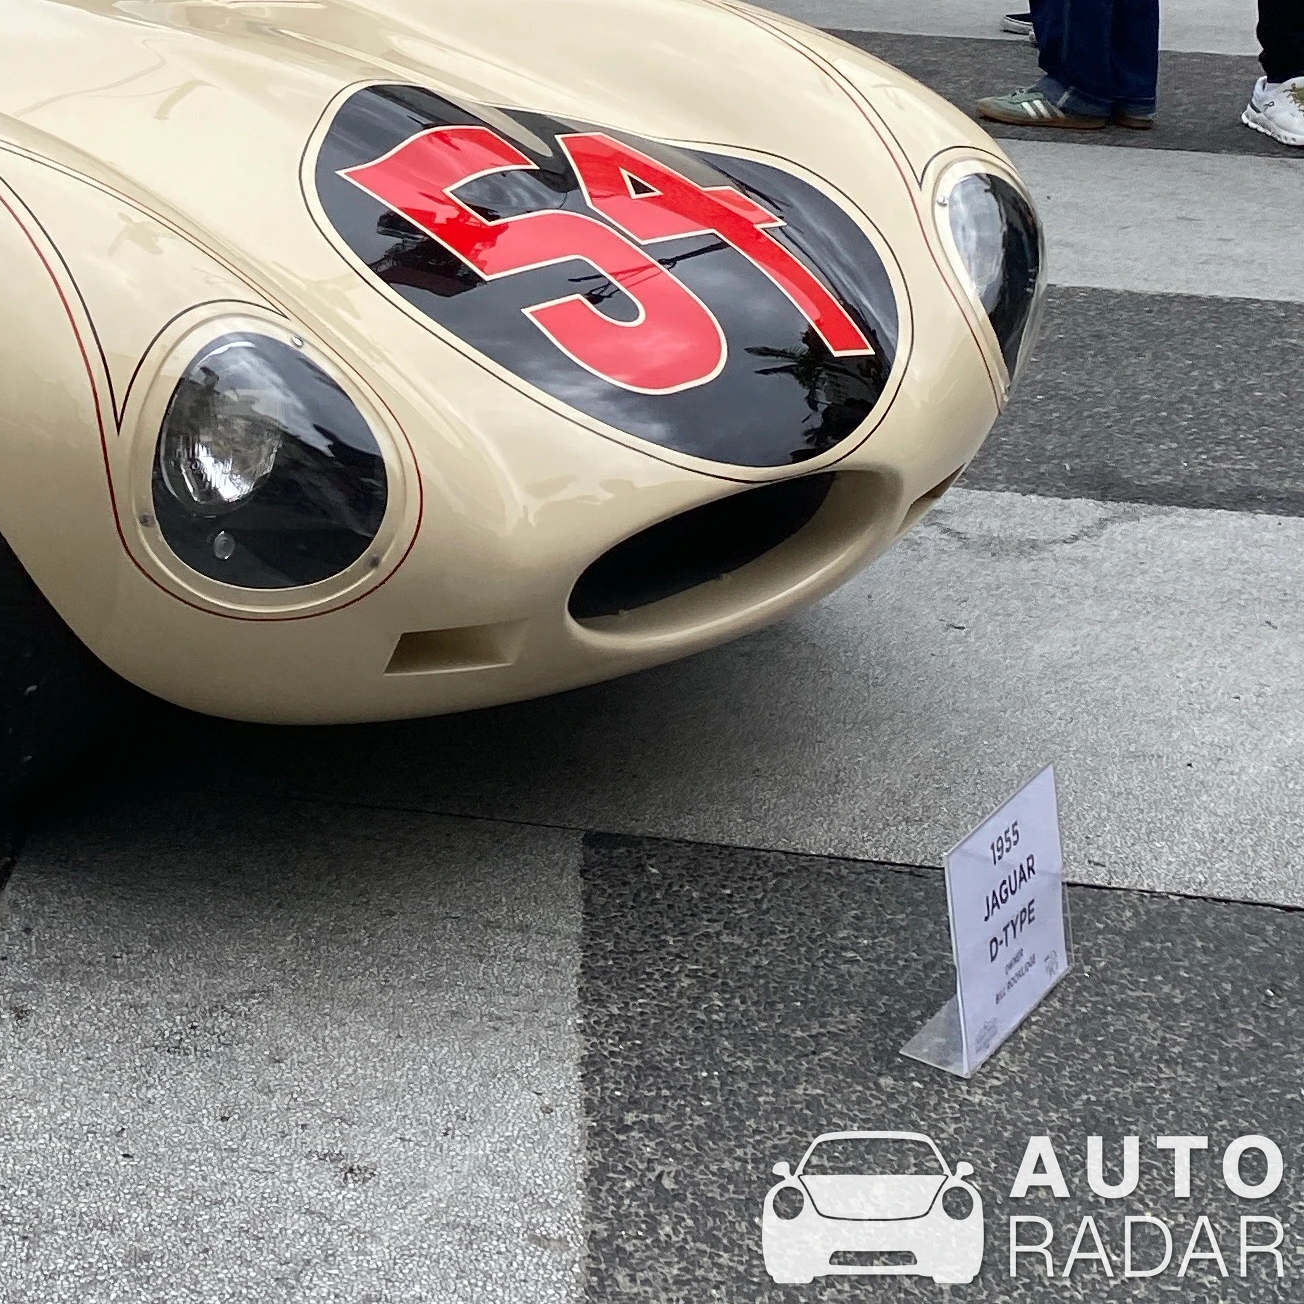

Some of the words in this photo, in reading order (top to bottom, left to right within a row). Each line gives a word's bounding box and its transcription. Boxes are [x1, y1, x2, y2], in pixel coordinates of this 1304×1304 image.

[336, 125, 876, 396] 54
[989, 820, 1021, 866] 1955
[983, 854, 1036, 922] JAGUAR
[989, 899, 1036, 963] D-TYPE
